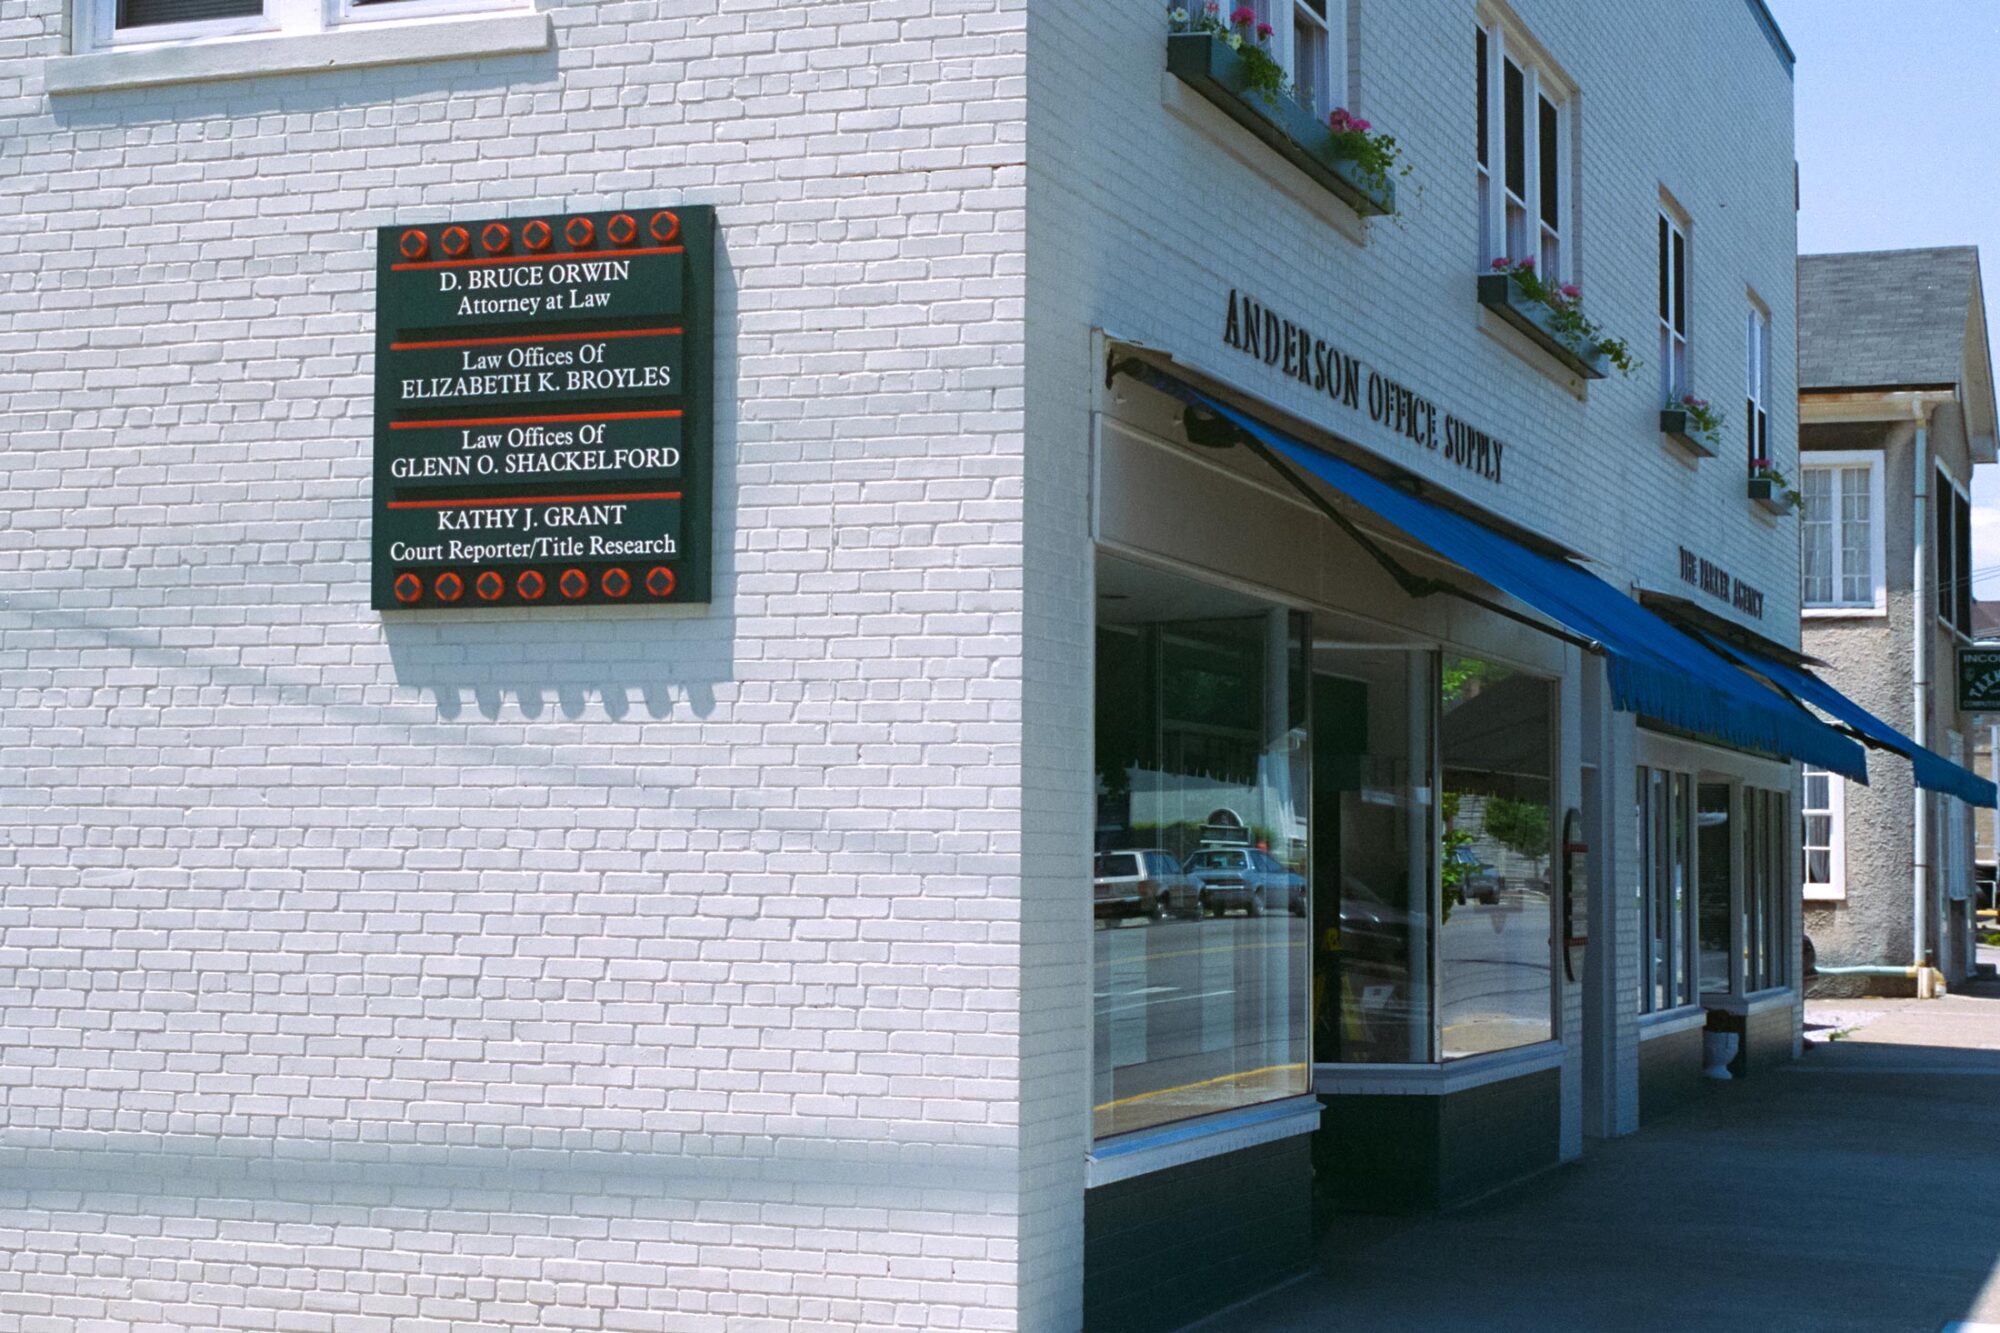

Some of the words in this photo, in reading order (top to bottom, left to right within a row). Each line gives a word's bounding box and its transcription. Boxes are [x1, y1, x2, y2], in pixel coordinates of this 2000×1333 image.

[440, 272, 461, 291] D.
[468, 266, 543, 289] BRUCE
[549, 261, 630, 284] ORWIN
[458, 296, 541, 315] Attorney
[546, 294, 563, 309] at
[570, 290, 610, 308] Law
[463, 351, 502, 370] Law
[508, 347, 573, 367] Offices
[579, 343, 606, 363] Of
[402, 373, 531, 399] ELIZABETH
[538, 372, 560, 391] K.
[567, 366, 670, 390] BROYLES
[1224, 288, 1360, 410] ANDERSON
[1368, 371, 1437, 449] OFFICE
[1445, 414, 1503, 484] SUPPLY
[462, 430, 502, 449] Law
[508, 427, 573, 447] Offices
[579, 424, 606, 444] Of
[391, 456, 471, 478] GLENN
[477, 455, 498, 474] O.
[505, 446, 679, 473] SHACKELFORD
[438, 509, 518, 530] KATHY
[523, 508, 537, 531] J.
[544, 505, 627, 526] GRANT
[391, 542, 443, 561] Court
[449, 537, 583, 563] Reporter/Title
[590, 534, 676, 555] Research
[1679, 546, 1697, 586] THE
[1733, 578, 1764, 620] AGENCY
[1963, 654, 2000, 663] INCO
